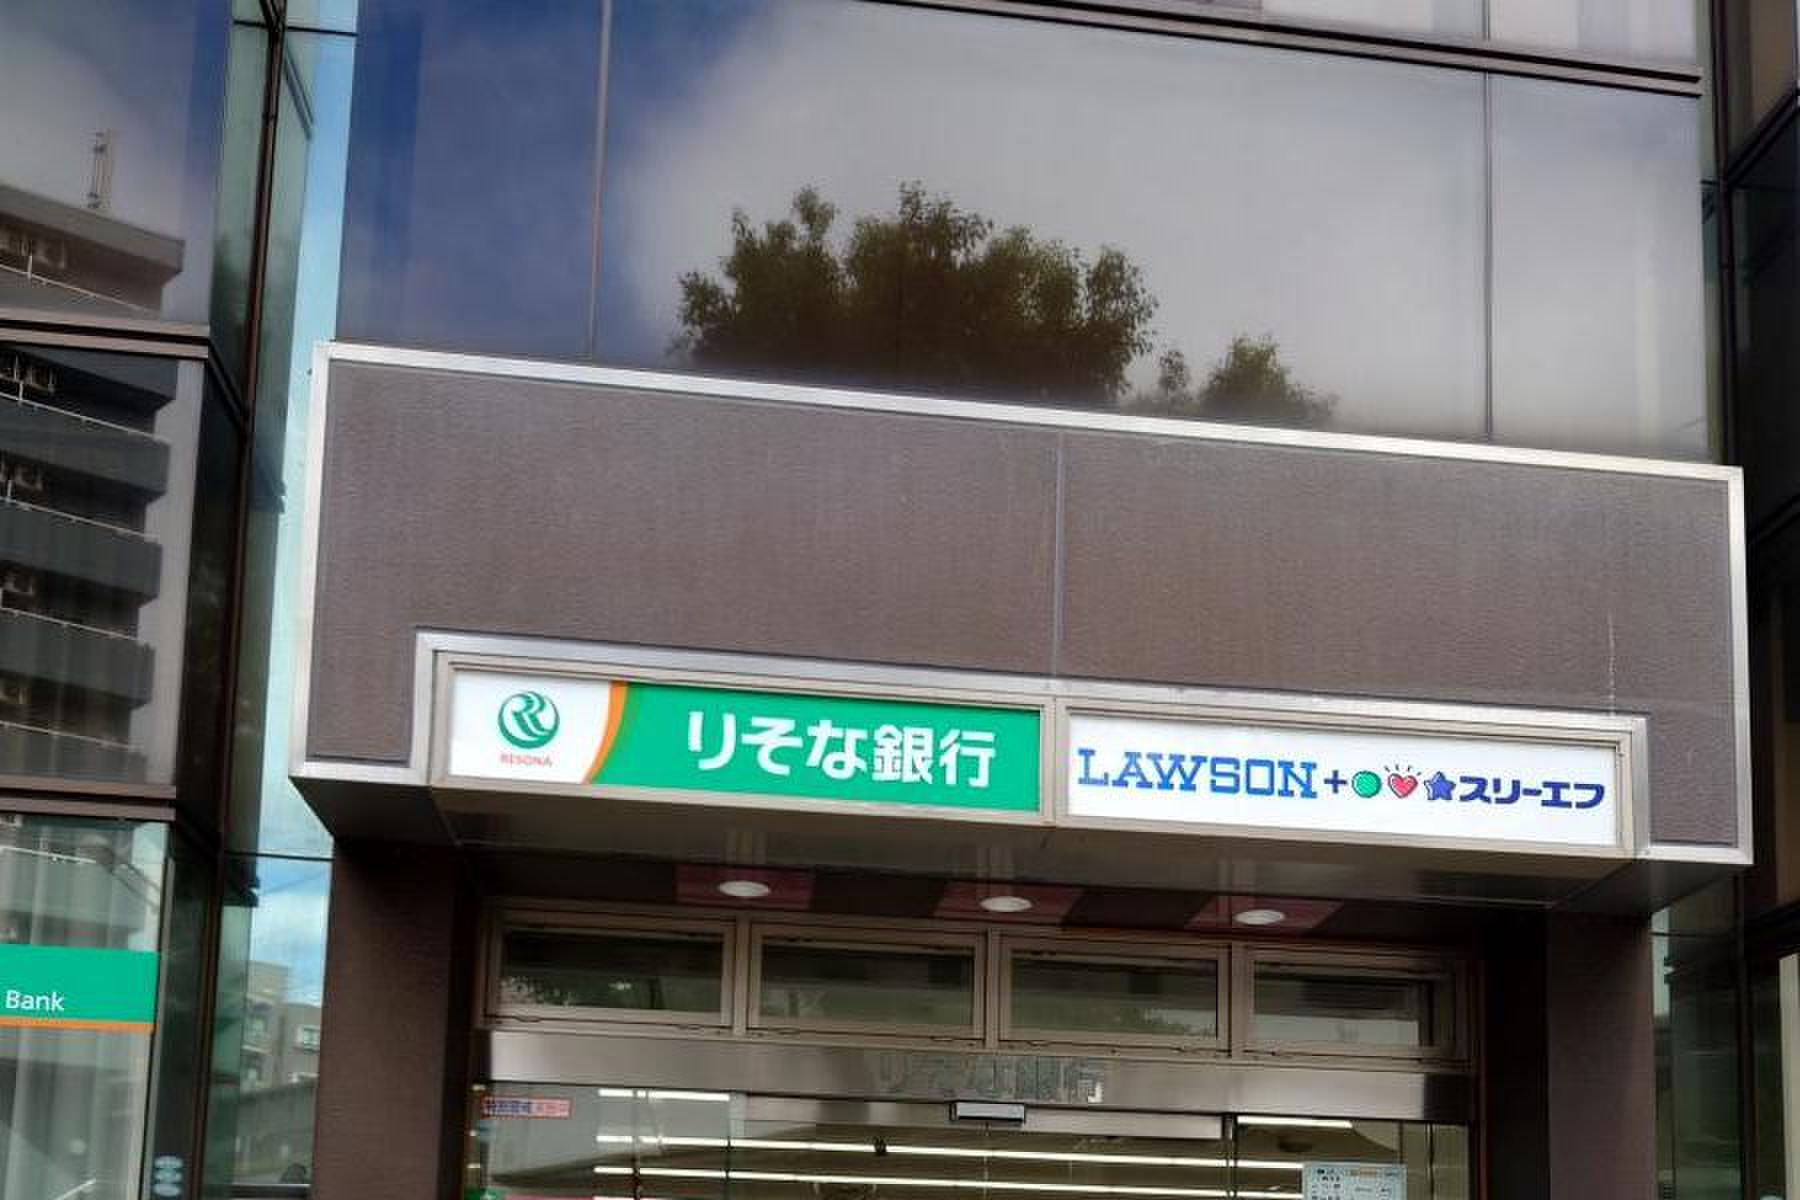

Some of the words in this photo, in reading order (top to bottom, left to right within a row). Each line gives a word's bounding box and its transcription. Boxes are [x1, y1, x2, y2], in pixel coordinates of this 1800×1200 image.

[500, 752, 554, 768] RESONA
[687, 710, 996, 788] りそな銀行
[1077, 748, 1318, 800] LAWSON
[1459, 776, 1606, 810] スリーエフ
[5, 989, 65, 1012] Bank
